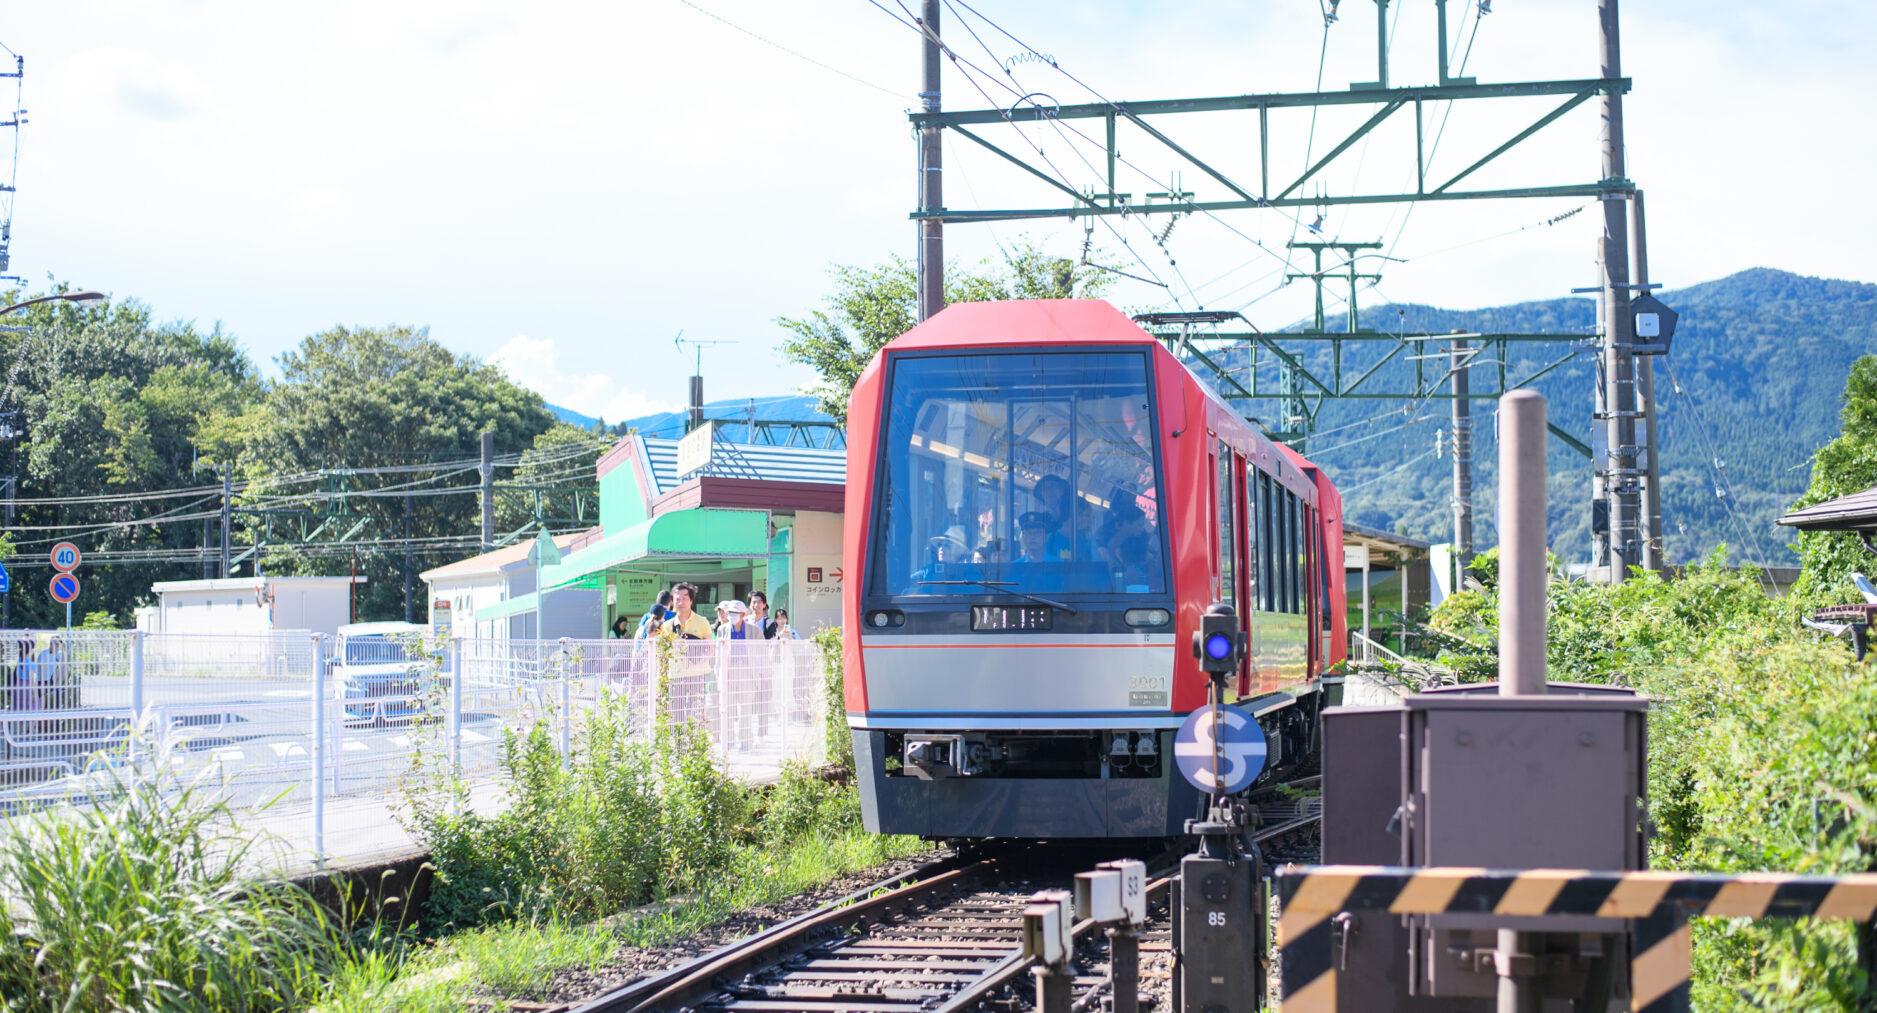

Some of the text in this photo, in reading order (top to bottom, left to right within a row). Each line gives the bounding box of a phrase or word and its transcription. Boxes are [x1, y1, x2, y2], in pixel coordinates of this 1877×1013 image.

[58, 551, 74, 564] 40
[1128, 675, 1165, 689] 3001
[1208, 912, 1226, 926] 85
